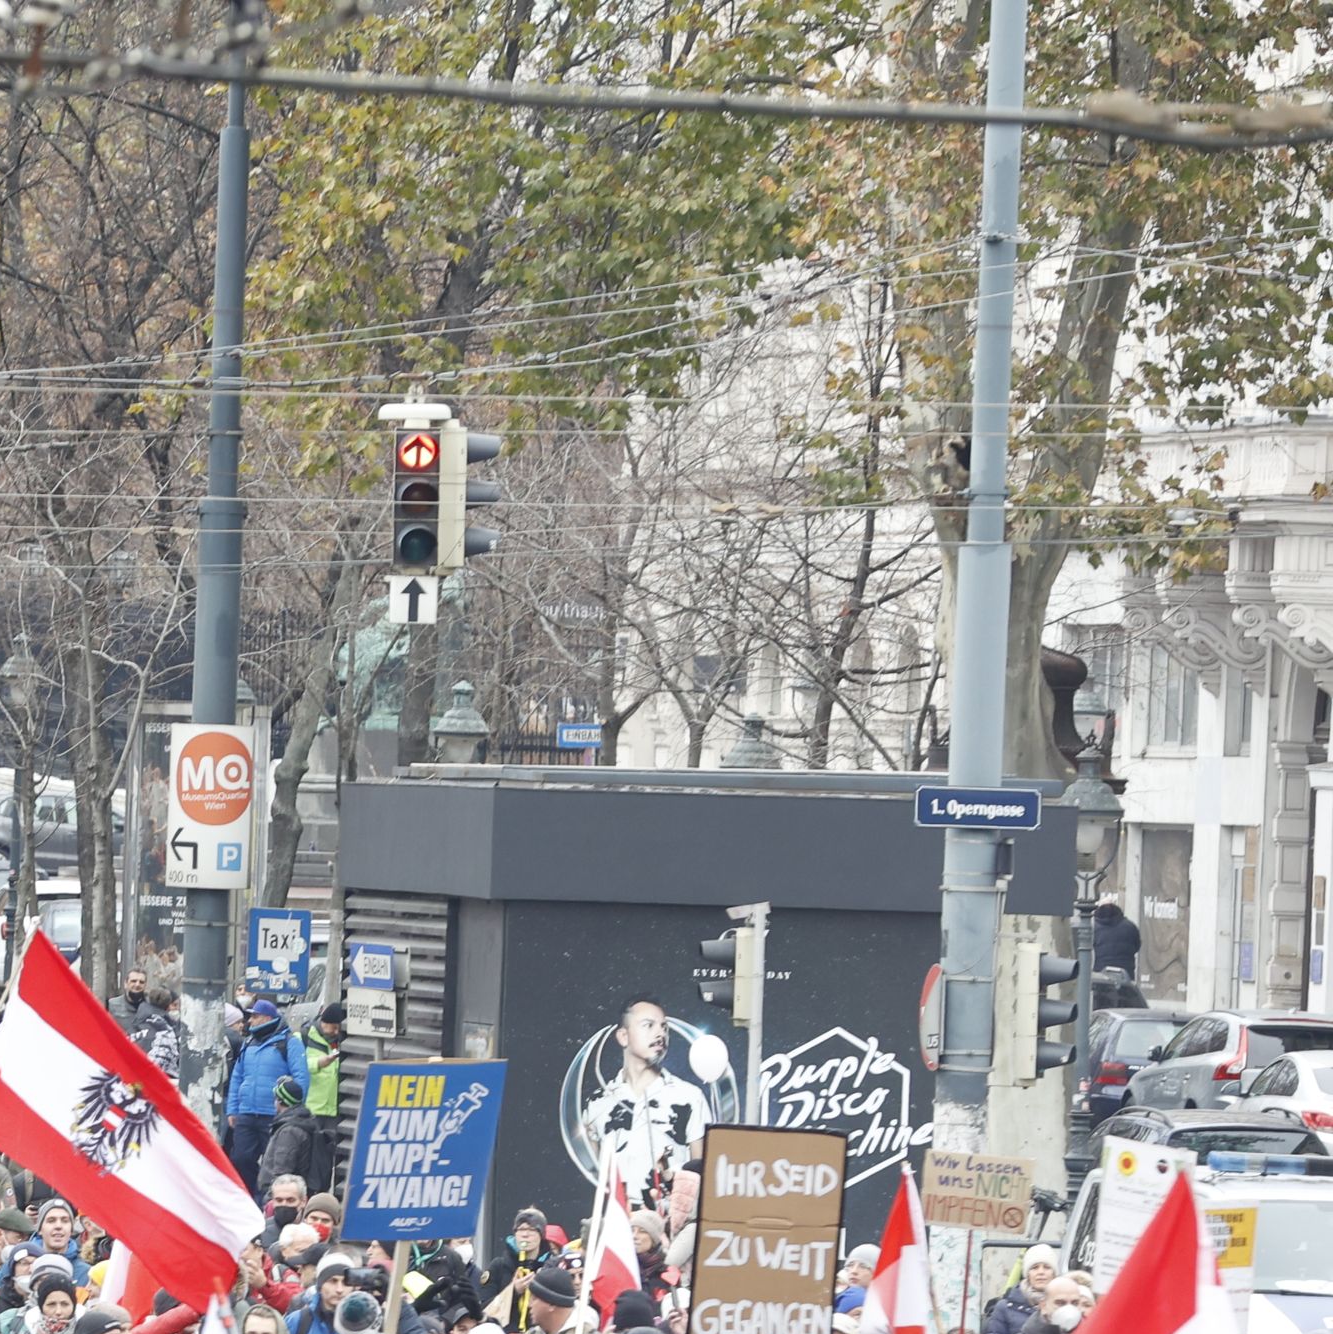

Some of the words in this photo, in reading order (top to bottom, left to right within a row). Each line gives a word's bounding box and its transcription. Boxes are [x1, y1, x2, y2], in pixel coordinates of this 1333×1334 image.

[182, 755, 251, 791] MQ
[205, 801, 226, 811] Wien
[947, 800, 1026, 820] Operngasse
[262, 927, 296, 950] Taxi
[767, 970, 793, 981] DAY
[760, 1036, 896, 1098] Purple
[376, 1075, 446, 1109] NEIN
[777, 1086, 891, 1128] Disco
[370, 1109, 439, 1143] ZUM
[364, 1142, 451, 1176] IMPF-
[715, 1153, 767, 1198] IHR
[767, 1157, 839, 1198] SEID
[934, 1154, 960, 1170] Wir
[357, 1175, 473, 1209] ZWANG!
[938, 1174, 974, 1189] uns
[975, 1174, 1031, 1199] NICHT
[926, 1194, 1003, 1229] IMPFEN
[703, 1229, 751, 1268] ZU
[754, 1235, 836, 1282] WEIT
